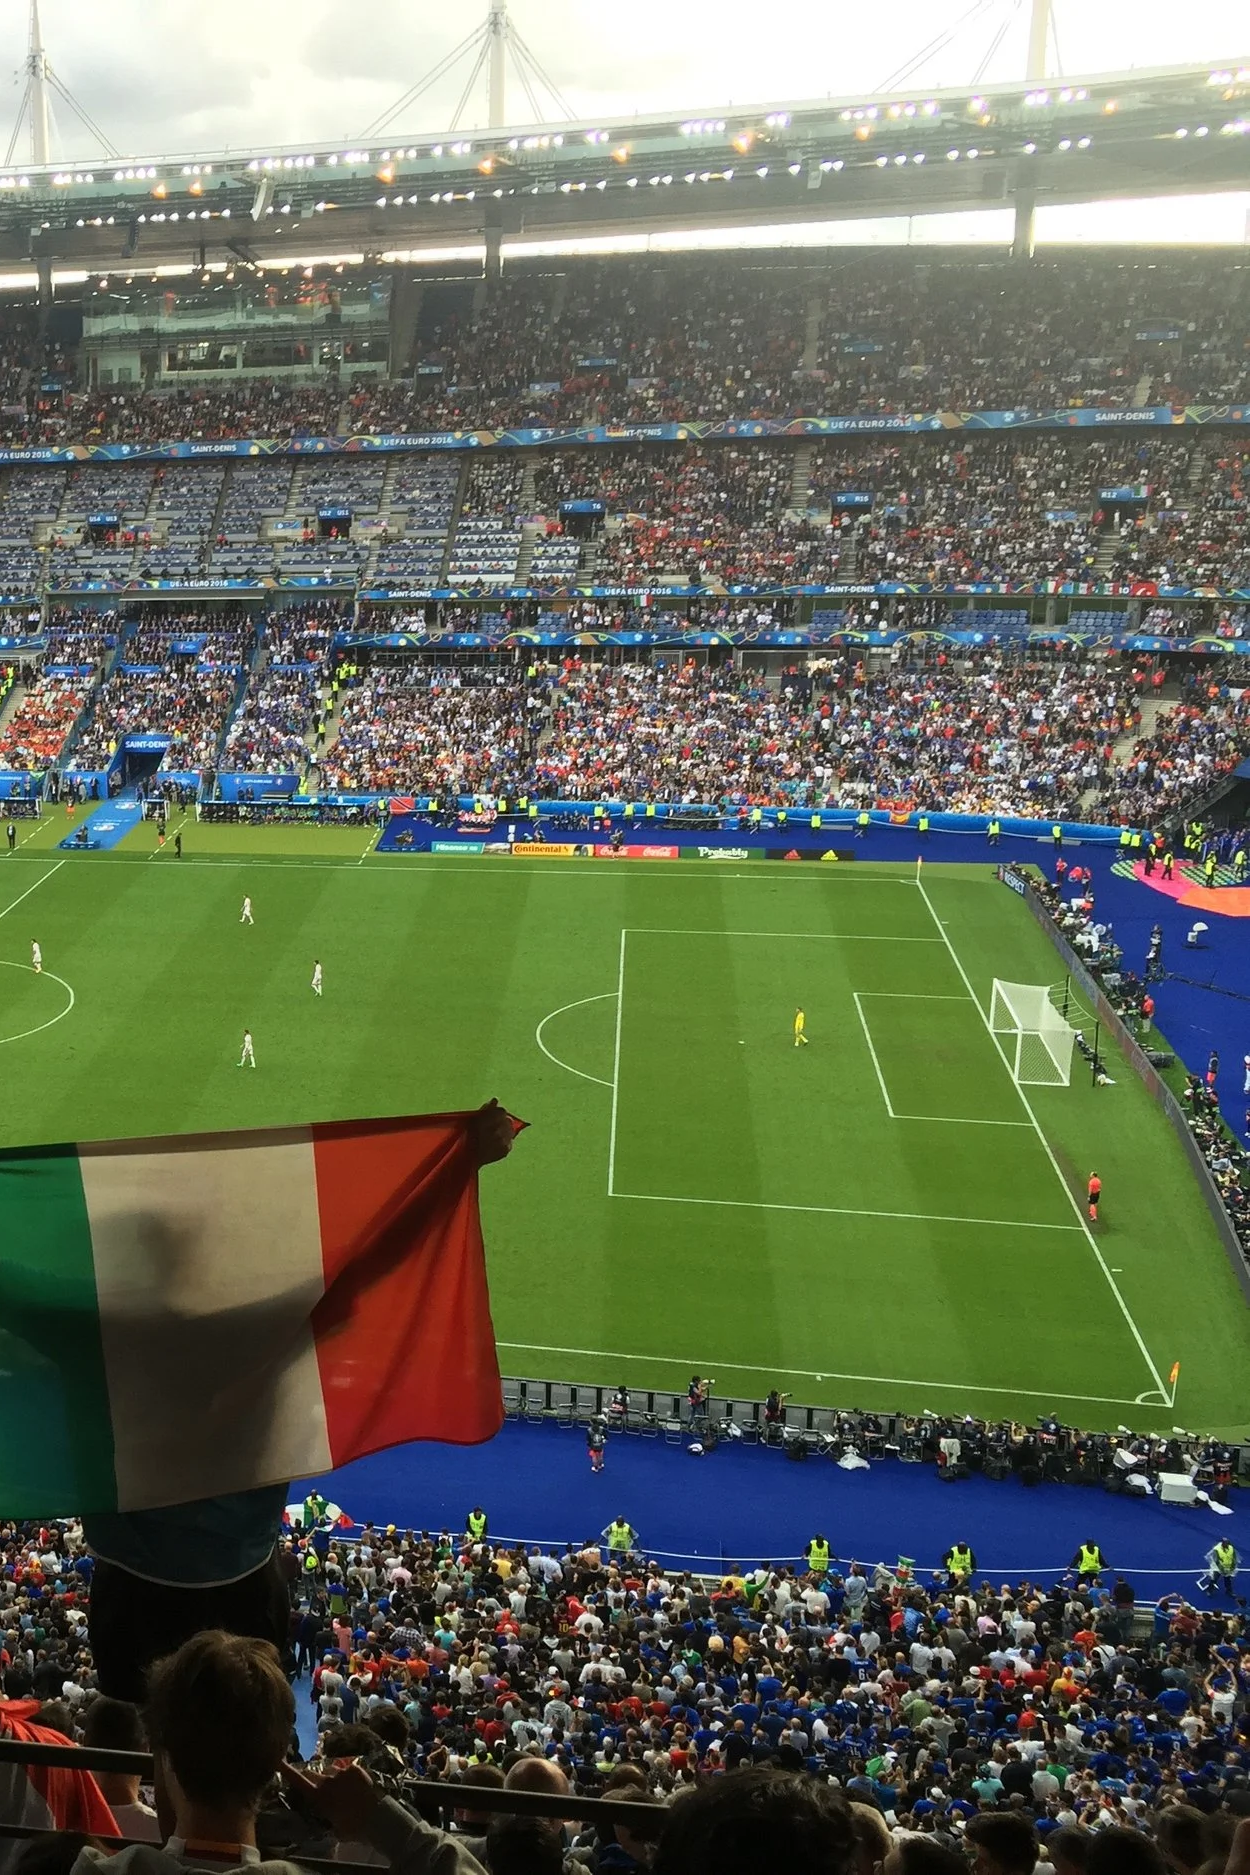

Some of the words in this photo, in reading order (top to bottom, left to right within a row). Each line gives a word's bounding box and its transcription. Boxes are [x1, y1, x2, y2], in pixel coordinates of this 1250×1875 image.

[1095, 411, 1155, 421] SAINT-DENIS
[830, 420, 856, 429] UEFA
[858, 419, 885, 428] EURO
[383, 438, 405, 446] UEFA
[407, 437, 430, 445] EURO
[431, 436, 453, 444] 2016
[191, 444, 237, 453] SAINT-DENIS
[9, 451, 30, 459] EURO
[31, 450, 51, 458] 2016
[210, 579, 228, 587] 2016
[605, 587, 626, 595] UEFA
[628, 587, 649, 595] EURO
[651, 587, 671, 595] 2016
[825, 585, 875, 593] SAINT-DENIS
[388, 590, 432, 598] SAINT-DENIS
[514, 844, 561, 854] Continental
[697, 846, 748, 859] Probably
[559, 1623, 570, 1633] 10
